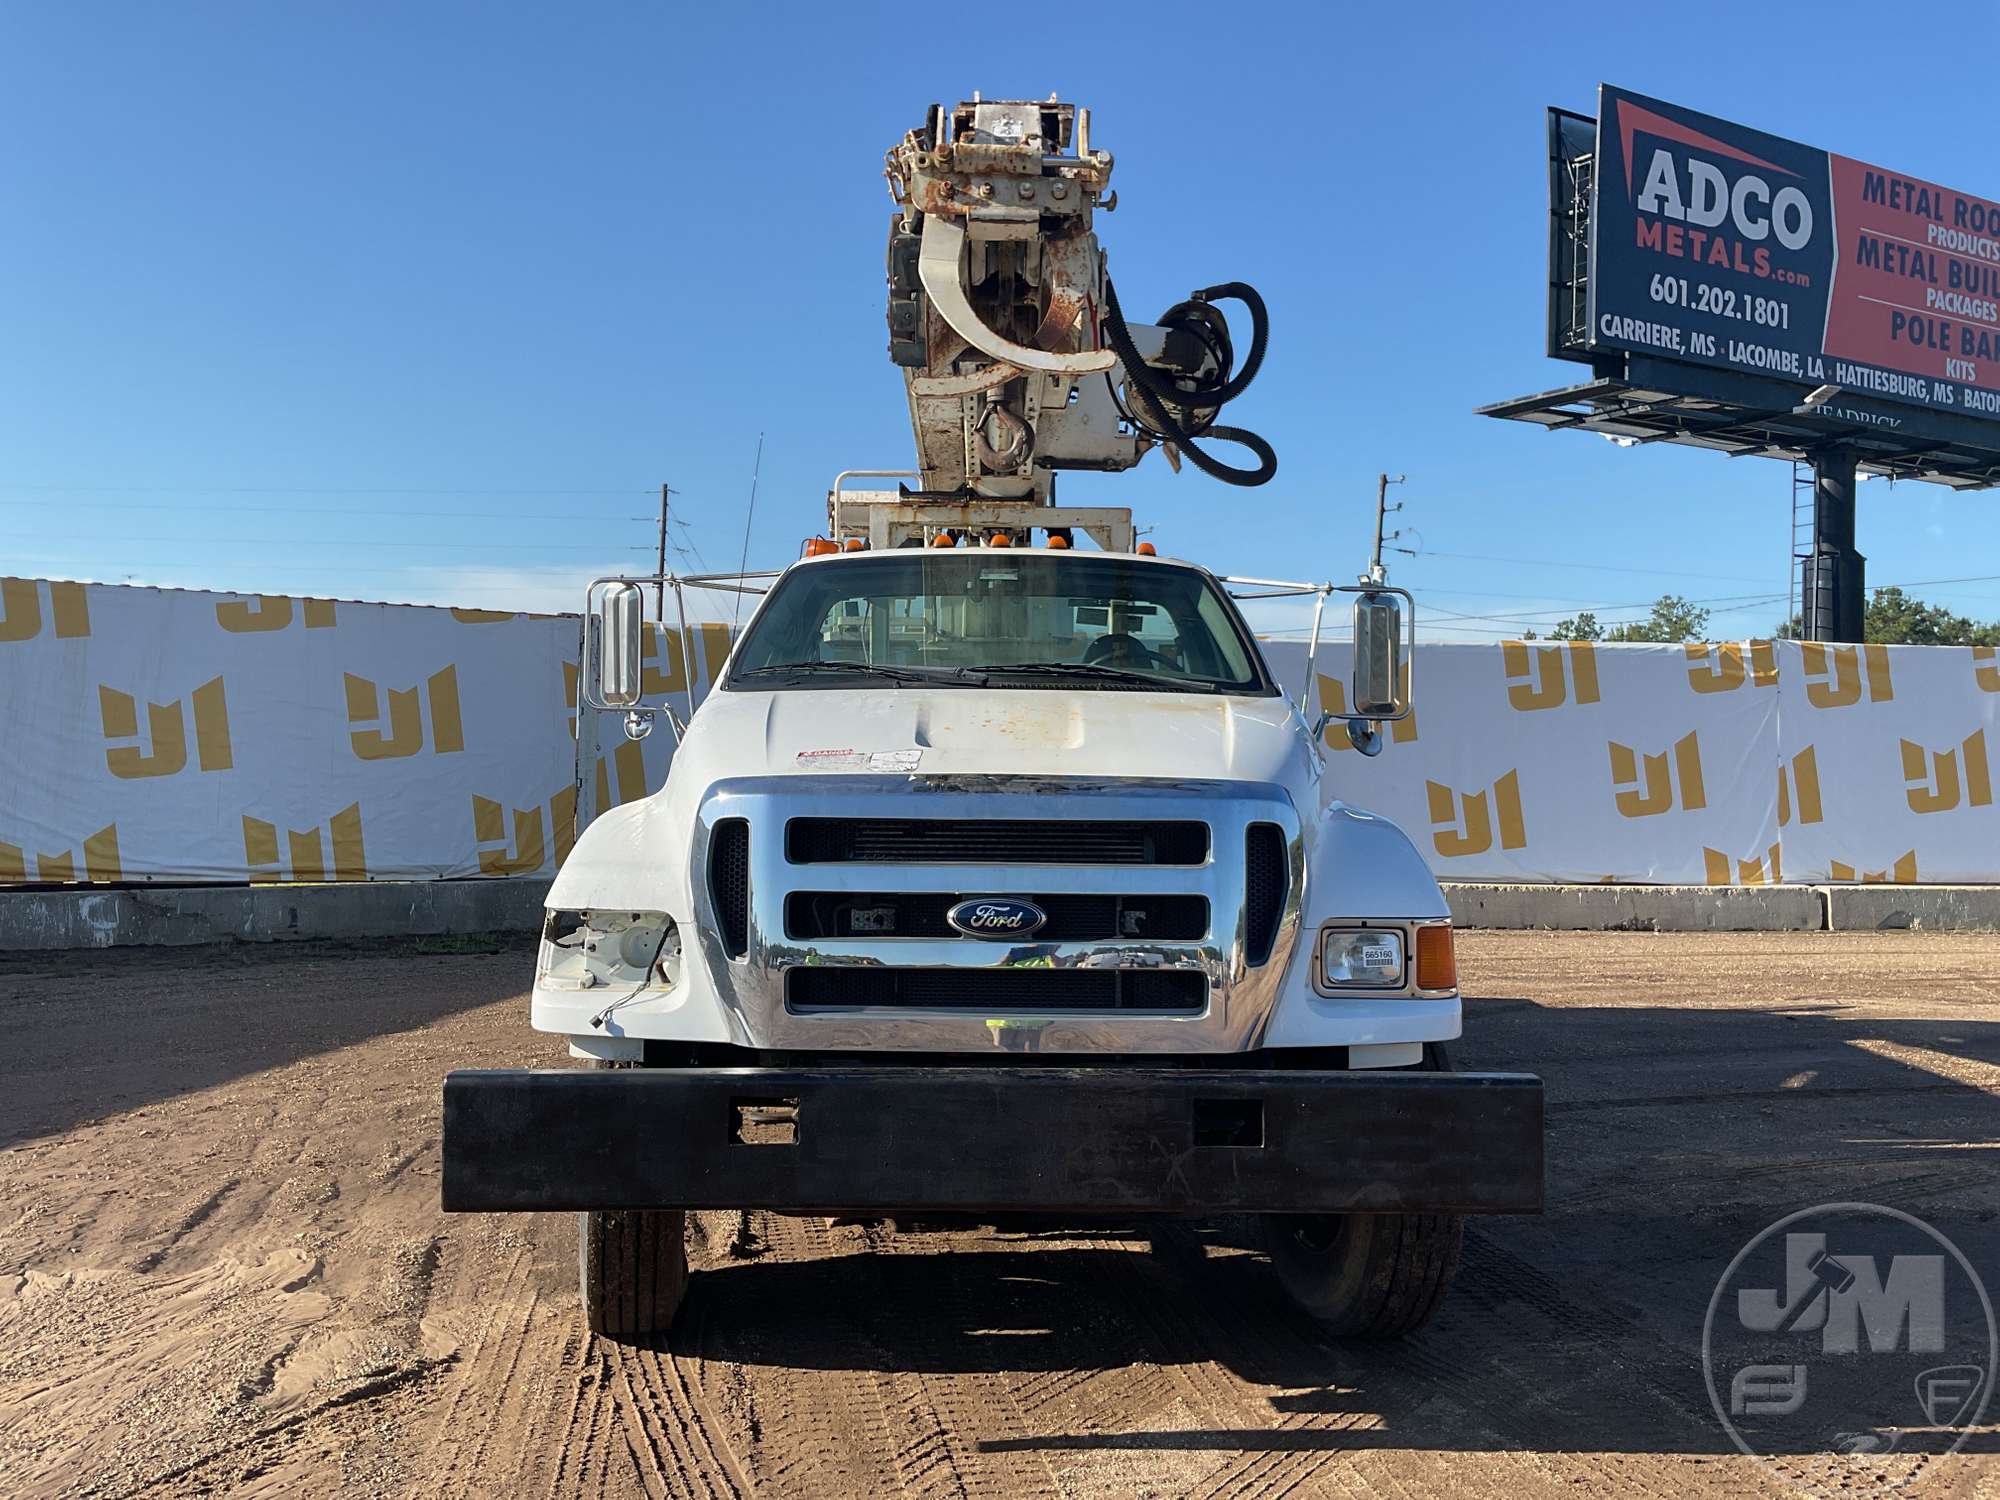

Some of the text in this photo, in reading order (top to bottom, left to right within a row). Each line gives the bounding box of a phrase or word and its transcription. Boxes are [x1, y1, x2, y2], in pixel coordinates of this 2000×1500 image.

[1637, 149, 1813, 250] ADCO
[1862, 171, 1944, 222] METAL
[1856, 235, 1938, 284] METAL
[1927, 223, 2000, 261] PRODUCTS
[1650, 273, 1789, 329] 601.202.1801
[1926, 287, 1998, 322] PACKAGES
[1891, 310, 1951, 352] POLE
[1600, 314, 1686, 356] CARRIERE,
[1690, 332, 1716, 357] MS
[1728, 340, 1804, 378] LACOMBE,
[1807, 356, 1825, 379] LA
[1836, 362, 1930, 404] HATTIESBURG,
[1933, 382, 1954, 404] MS
[1946, 358, 1977, 382] KITS
[970, 904, 1024, 928] Ford
[1365, 951, 1393, 959] 665160
